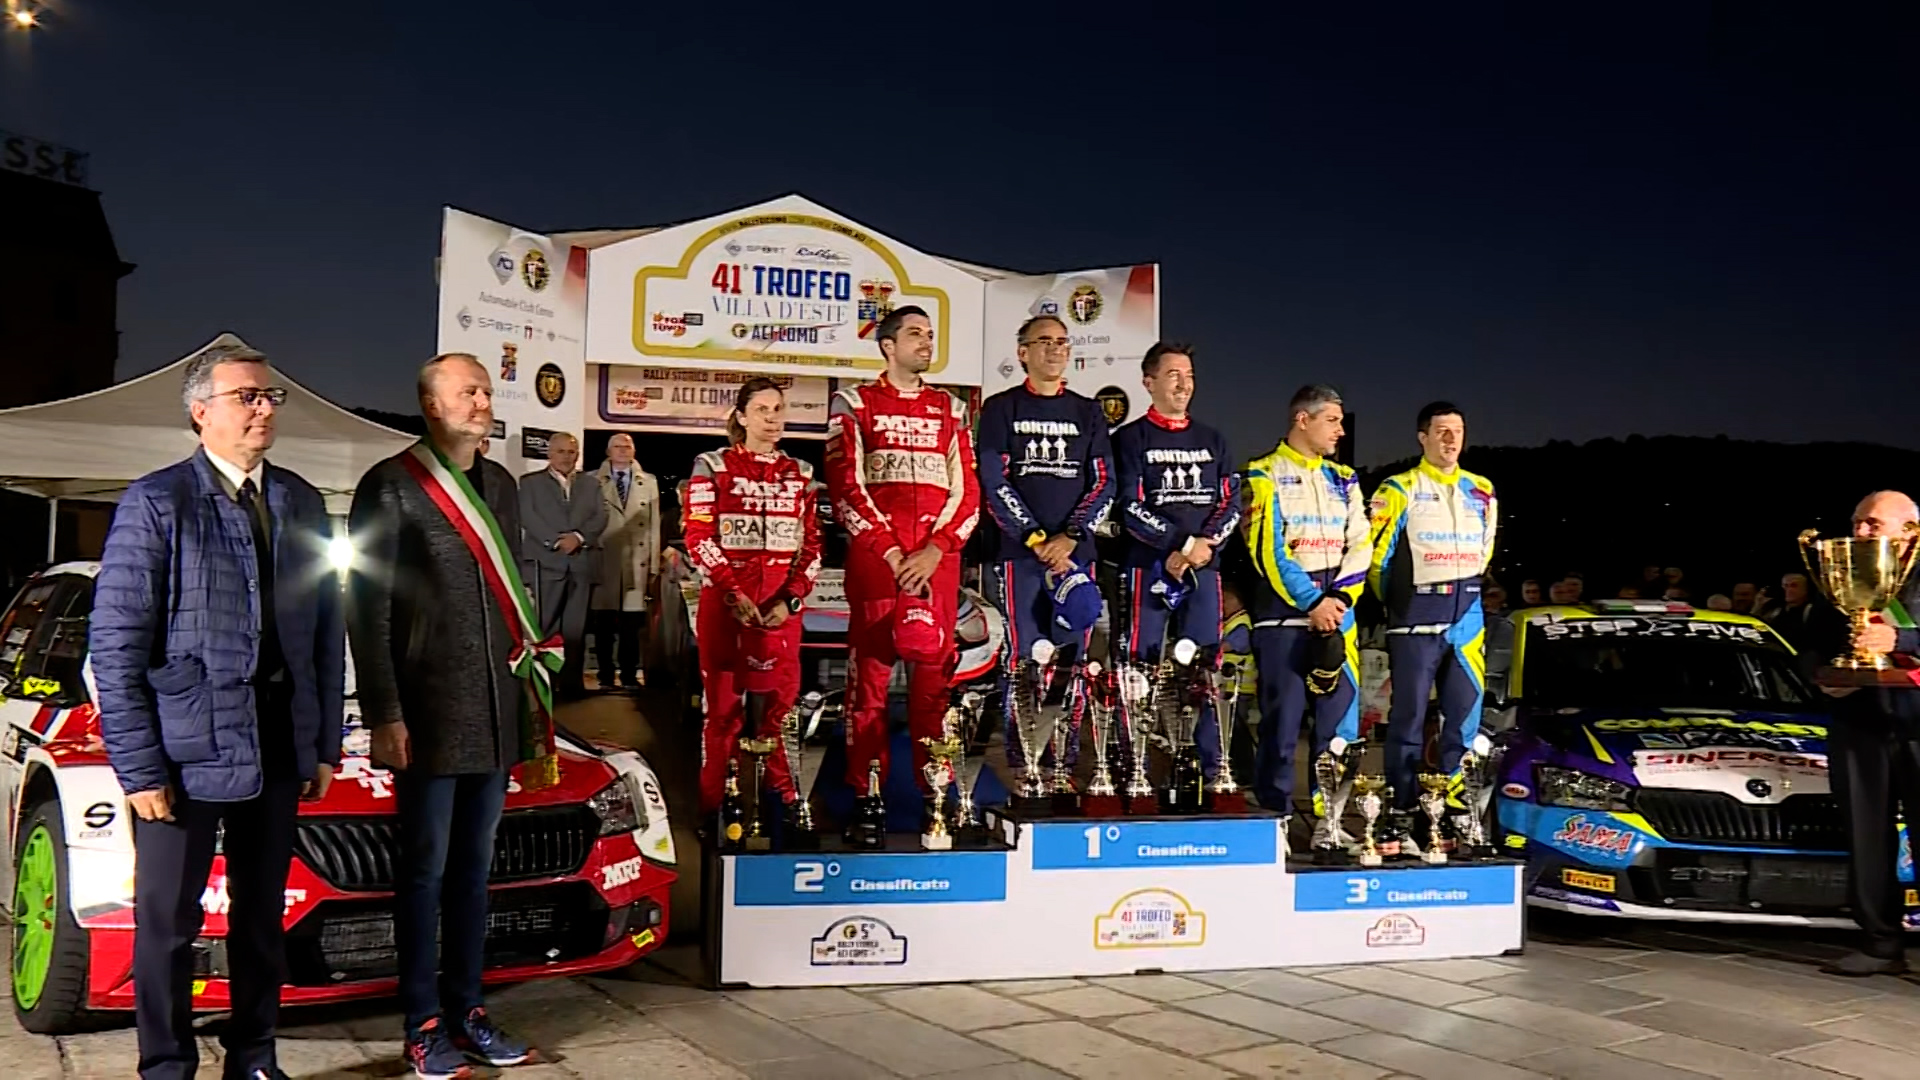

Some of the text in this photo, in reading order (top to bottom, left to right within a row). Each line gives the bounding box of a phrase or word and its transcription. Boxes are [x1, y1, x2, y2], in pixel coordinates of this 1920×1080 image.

[752, 264, 851, 301] TROFEO
[712, 295, 772, 318] VILLA
[778, 326, 819, 344] COMO
[643, 368, 670, 380] RALLY
[871, 414, 942, 434] MRF
[1013, 421, 1080, 436] FONTANA
[1146, 449, 1213, 464] FONTANA
[730, 476, 804, 499] MRF
[741, 497, 796, 512] TYRES
[1137, 843, 1228, 858] Classificato
[602, 856, 642, 890] MRF
[850, 877, 950, 892] Classificato
[1387, 888, 1469, 903] Classificato
